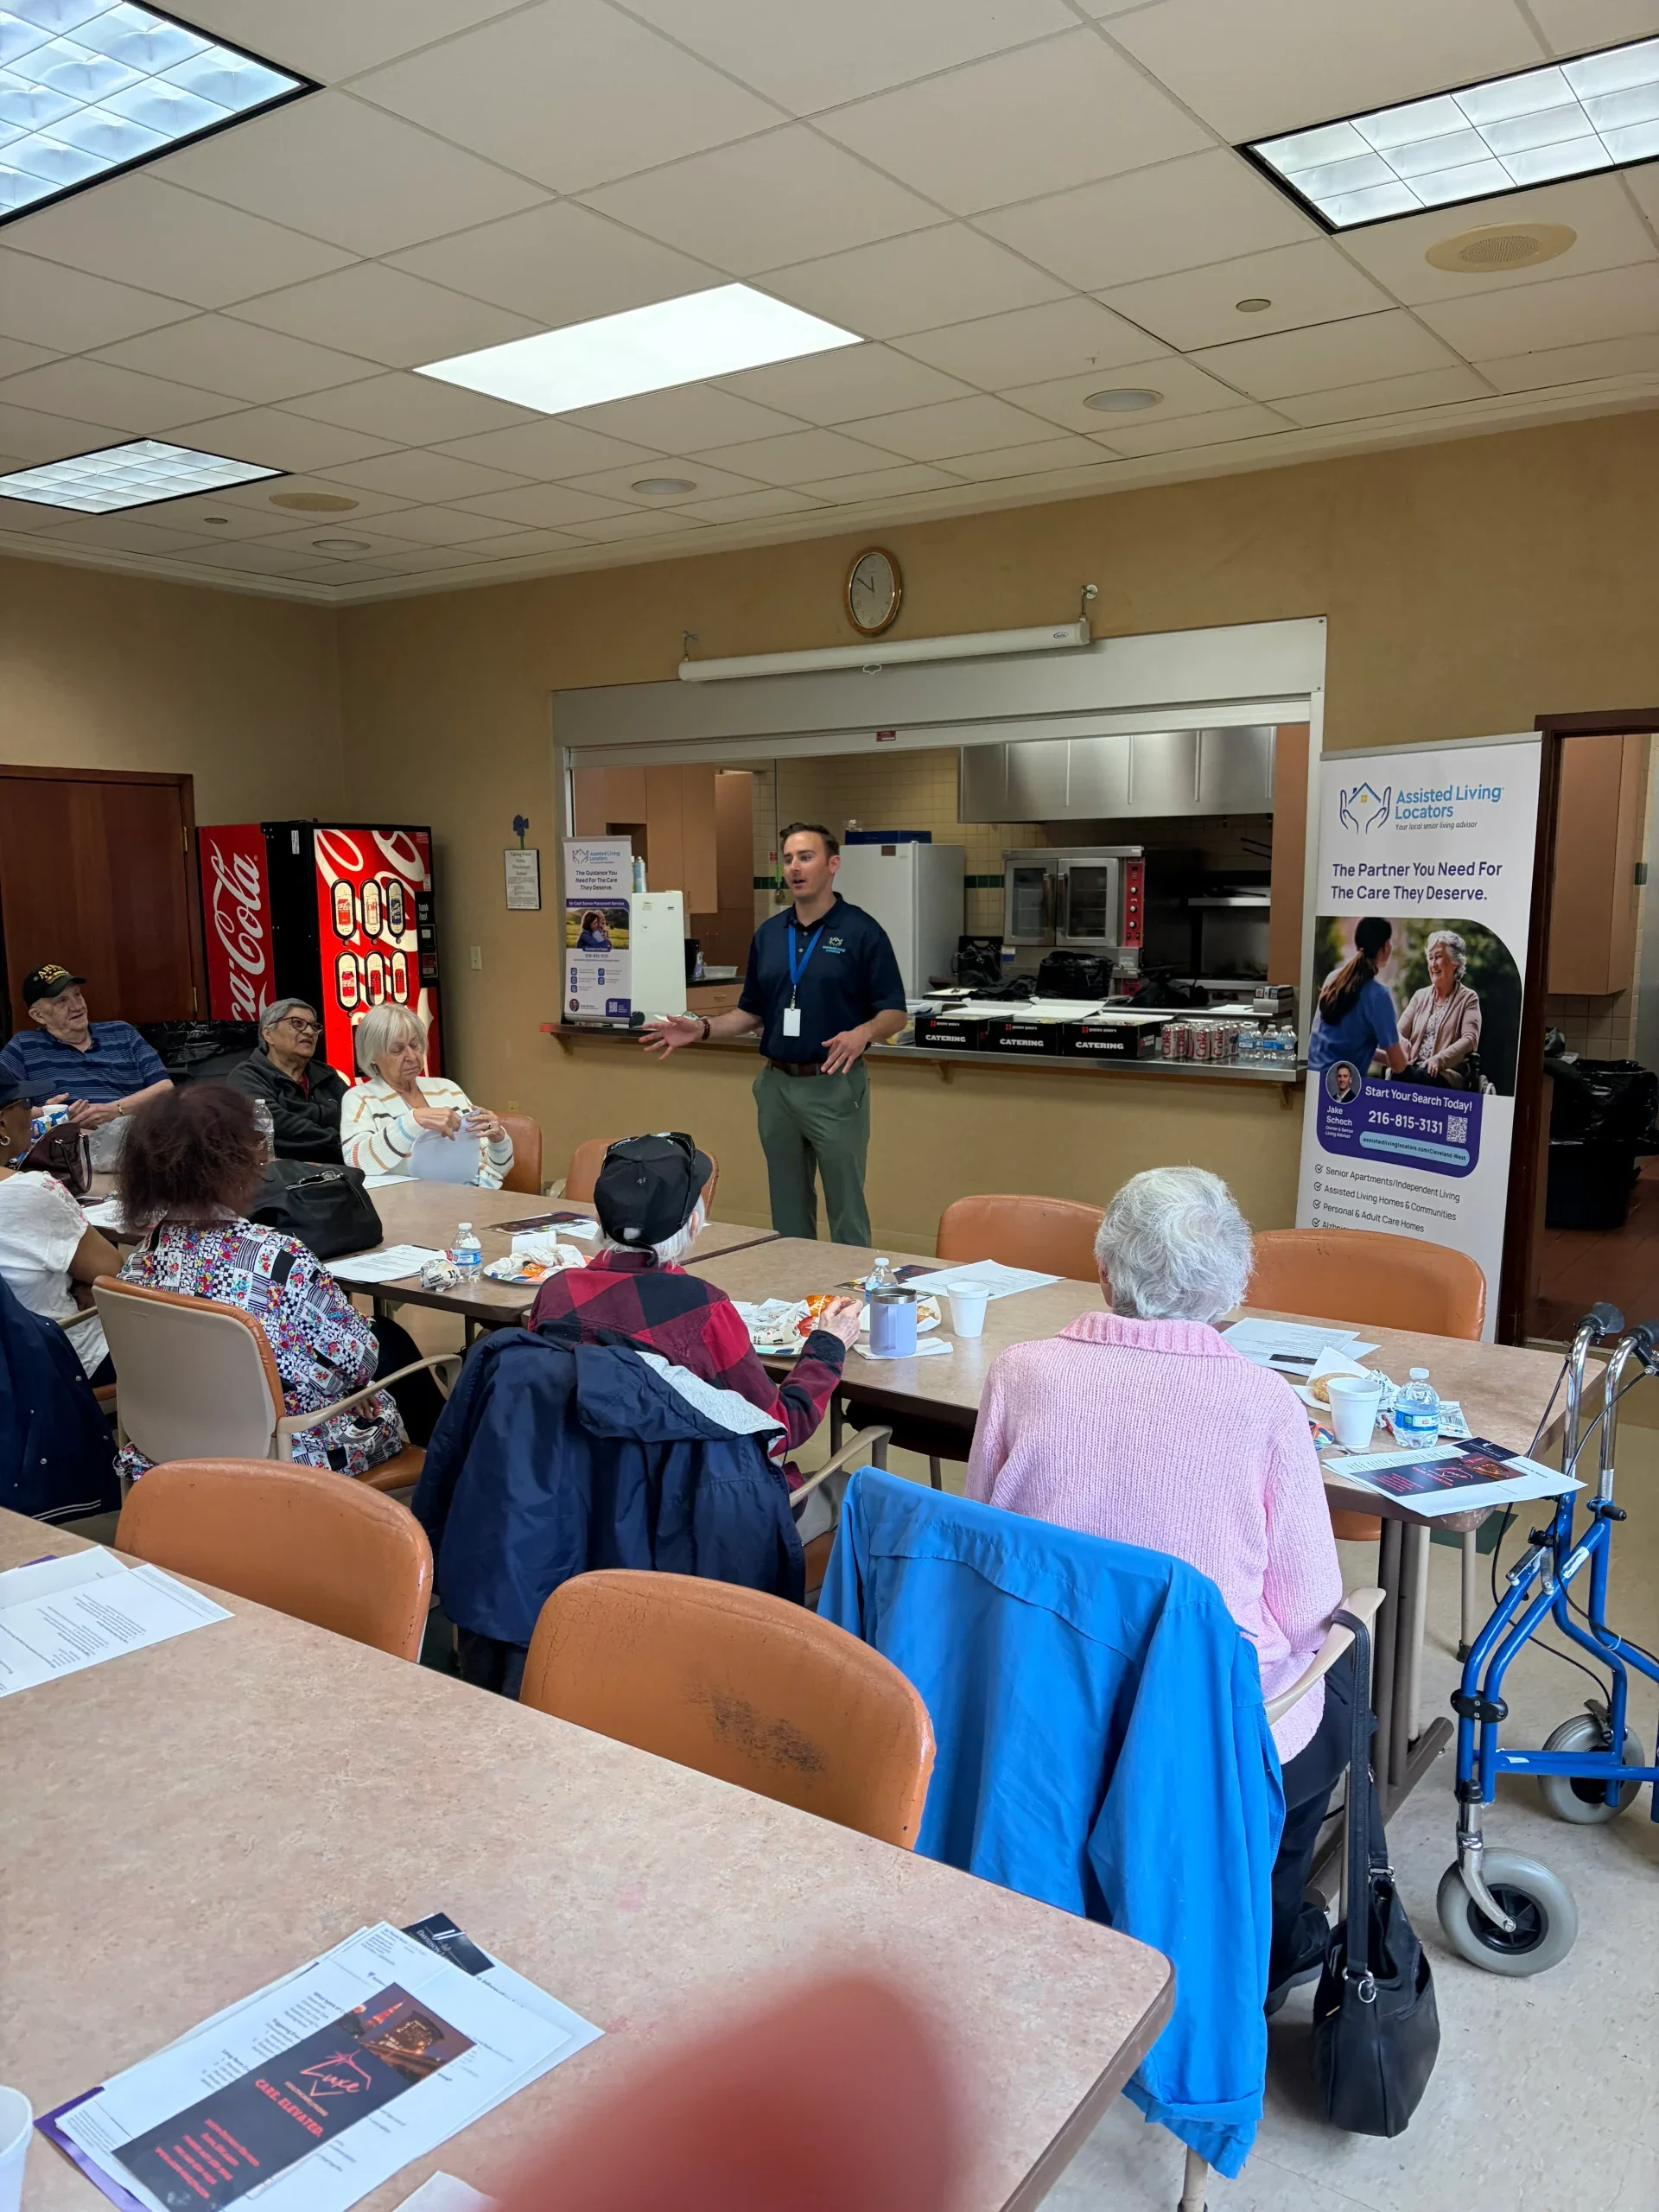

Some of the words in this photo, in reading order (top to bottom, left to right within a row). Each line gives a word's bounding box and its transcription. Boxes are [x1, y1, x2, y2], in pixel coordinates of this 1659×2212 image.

[1396, 785, 1452, 804] Assisted
[1456, 784, 1502, 803] Living
[1395, 804, 1453, 820] Locators
[1440, 821, 1455, 830] living
[1332, 863, 1355, 876] The
[1358, 863, 1410, 877] Partner
[1413, 862, 1435, 876] You
[1438, 861, 1475, 875] Need
[1478, 861, 1503, 875] For
[1331, 886, 1354, 899] The
[1357, 886, 1390, 899] Care
[1394, 886, 1424, 903] They
[1427, 886, 1488, 900] Deserve.
[1075, 1041, 1124, 1050] CATERING
[1196, 1029, 1207, 1058] Coke
[1213, 1029, 1224, 1057] Coke
[1326, 1106, 1344, 1115] Jake
[1365, 1086, 1389, 1098] Start
[1390, 1089, 1411, 1102] Your
[1412, 1092, 1442, 1107] Search
[1443, 1096, 1472, 1114] Today!
[1326, 1116, 1352, 1127] Schoch
[1368, 1109, 1443, 1135] 216-815-3131
[1325, 1166, 1349, 1179] Senior
[1350, 1170, 1439, 1197] Apartments/Independent
[1439, 1188, 1460, 1204] Living
[1325, 1185, 1355, 1198] Assisted
[1356, 1191, 1377, 1205] Living
[1378, 1195, 1404, 1208] Homes
[1411, 1202, 1457, 1221] Communities
[1323, 1203, 1354, 1217] Personal
[1355, 1209, 1360, 1217] &
[1361, 1210, 1381, 1223] Adult
[1382, 1215, 1400, 1226] Care
[1401, 1219, 1424, 1232] Homes
[255, 2078, 280, 2101] CARE.
[277, 2097, 324, 2138] ELEVATED.
